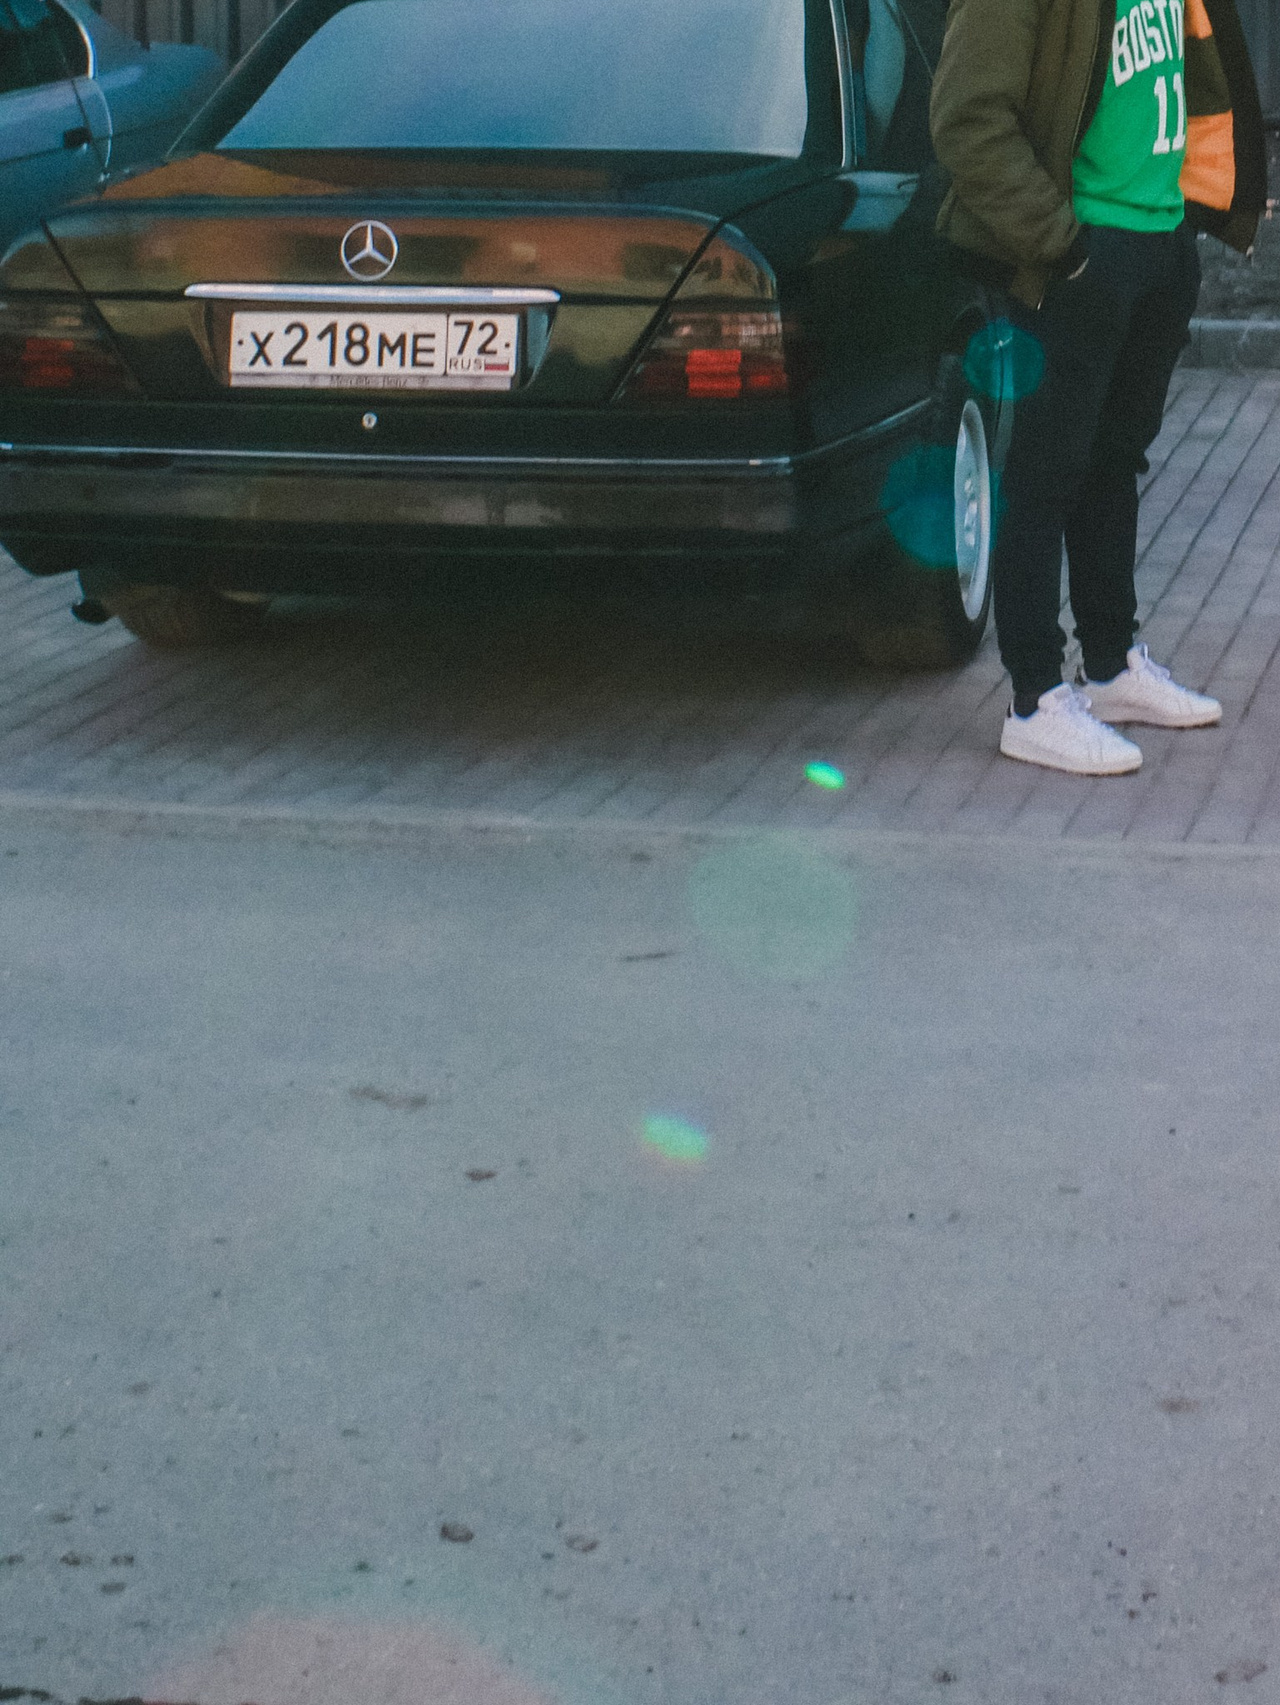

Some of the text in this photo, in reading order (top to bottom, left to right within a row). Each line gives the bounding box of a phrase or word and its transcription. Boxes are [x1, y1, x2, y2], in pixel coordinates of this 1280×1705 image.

[1152, 72, 1186, 155] 11
[453, 320, 498, 355] 72
[449, 358, 482, 370] RUS
